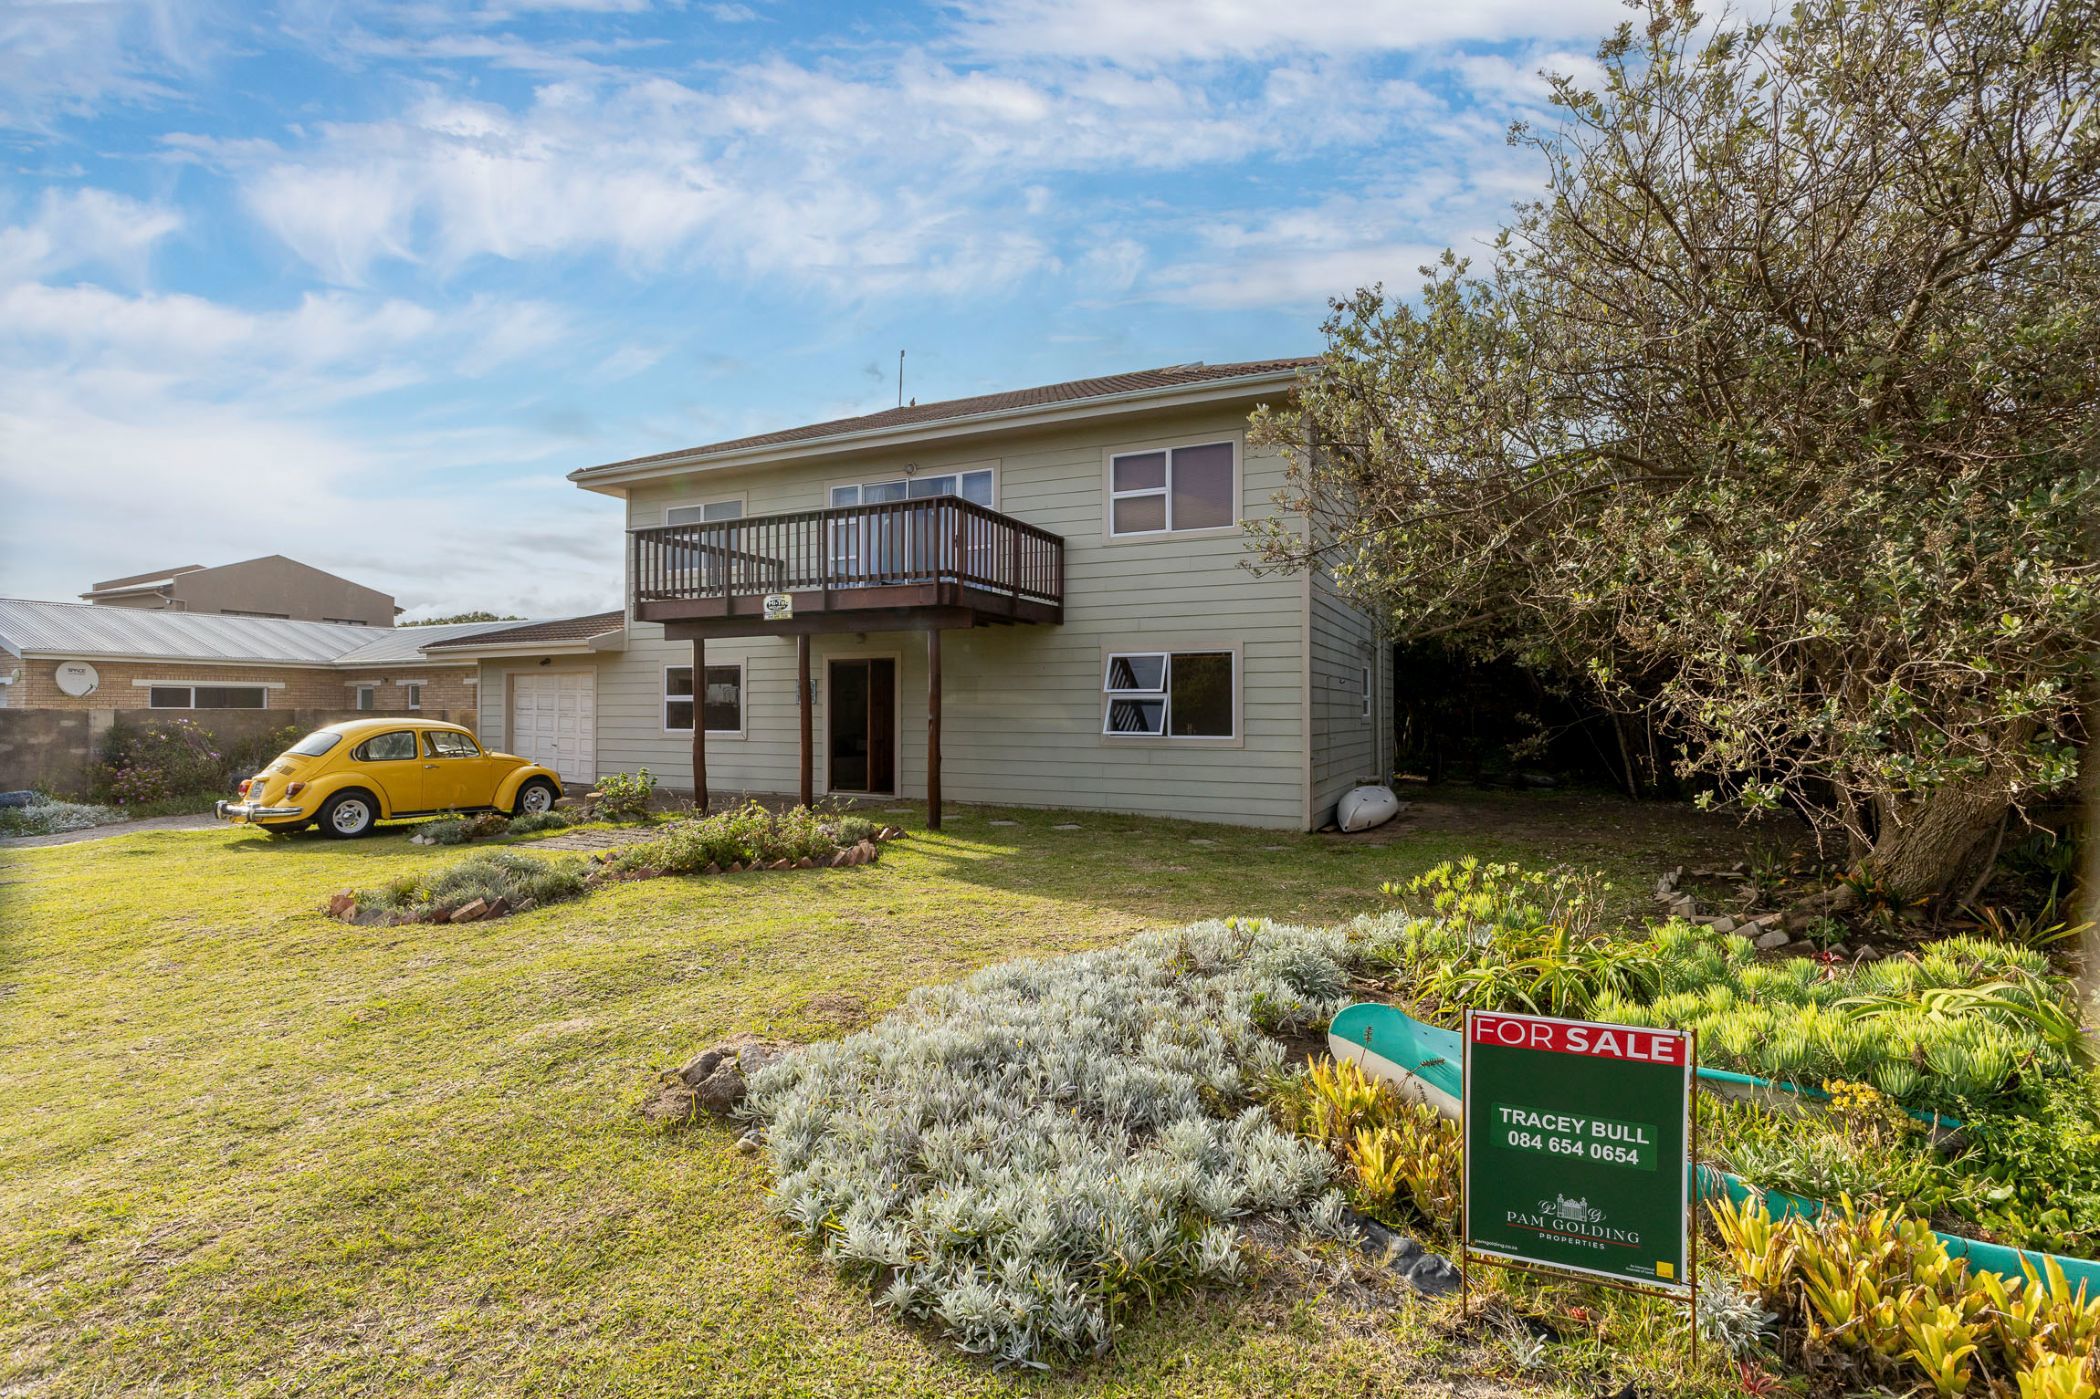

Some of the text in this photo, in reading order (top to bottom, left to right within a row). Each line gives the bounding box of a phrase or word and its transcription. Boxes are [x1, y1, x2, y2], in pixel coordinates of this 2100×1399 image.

[1476, 1018, 1675, 1062] FOR SALE
[1499, 1107, 1650, 1145] TRACEY BULL
[1508, 1130, 1640, 1165] 084 654 0654
[1507, 1211, 1640, 1244] PAM GOLDING
[1539, 1232, 1605, 1250] PROPERTIES
